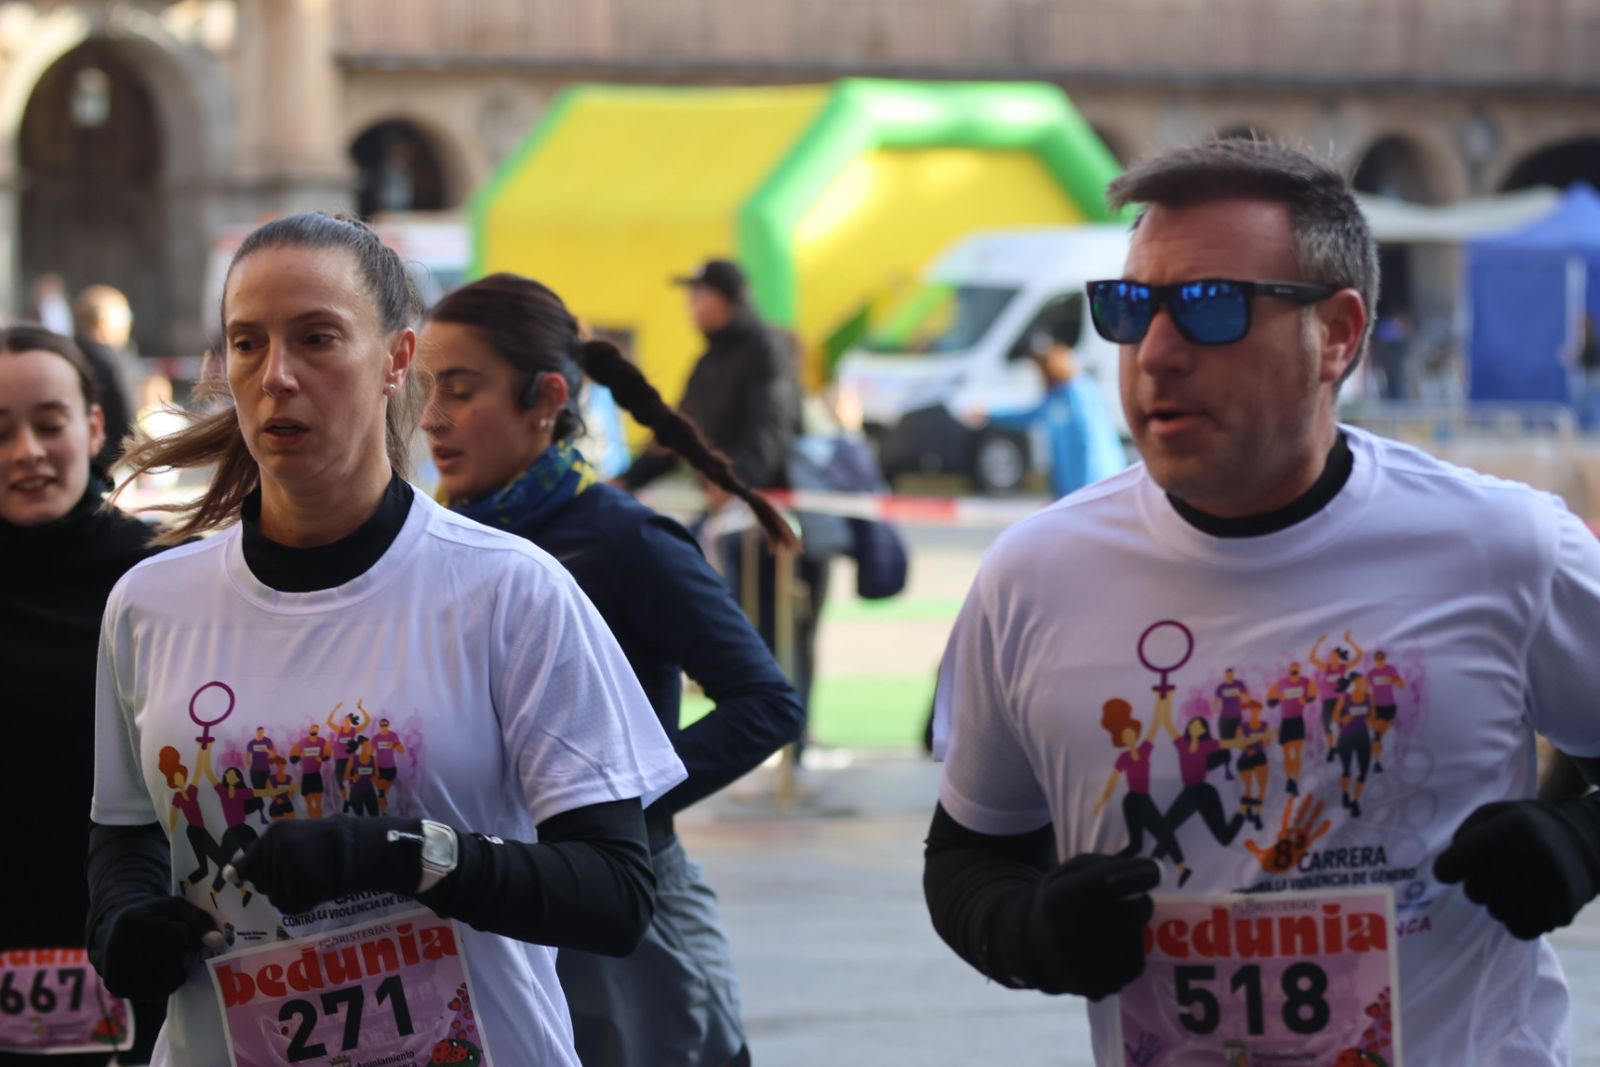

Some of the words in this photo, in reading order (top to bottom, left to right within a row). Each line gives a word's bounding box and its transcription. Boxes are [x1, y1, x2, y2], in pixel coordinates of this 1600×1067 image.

[1290, 873, 1350, 890] VIOLENCIA
[1351, 871, 1367, 885] DE
[1298, 846, 1388, 873] CARRERA
[282, 914, 316, 928] CONTRA
[317, 910, 329, 920] LA
[329, 899, 381, 920] VIOLENCIA
[382, 895, 395, 907] DE
[1143, 904, 1388, 959] edunia
[214, 923, 458, 1008] bedunia
[0, 968, 86, 1016] 667
[1174, 962, 1331, 1035] 518
[278, 974, 415, 1063] 271
